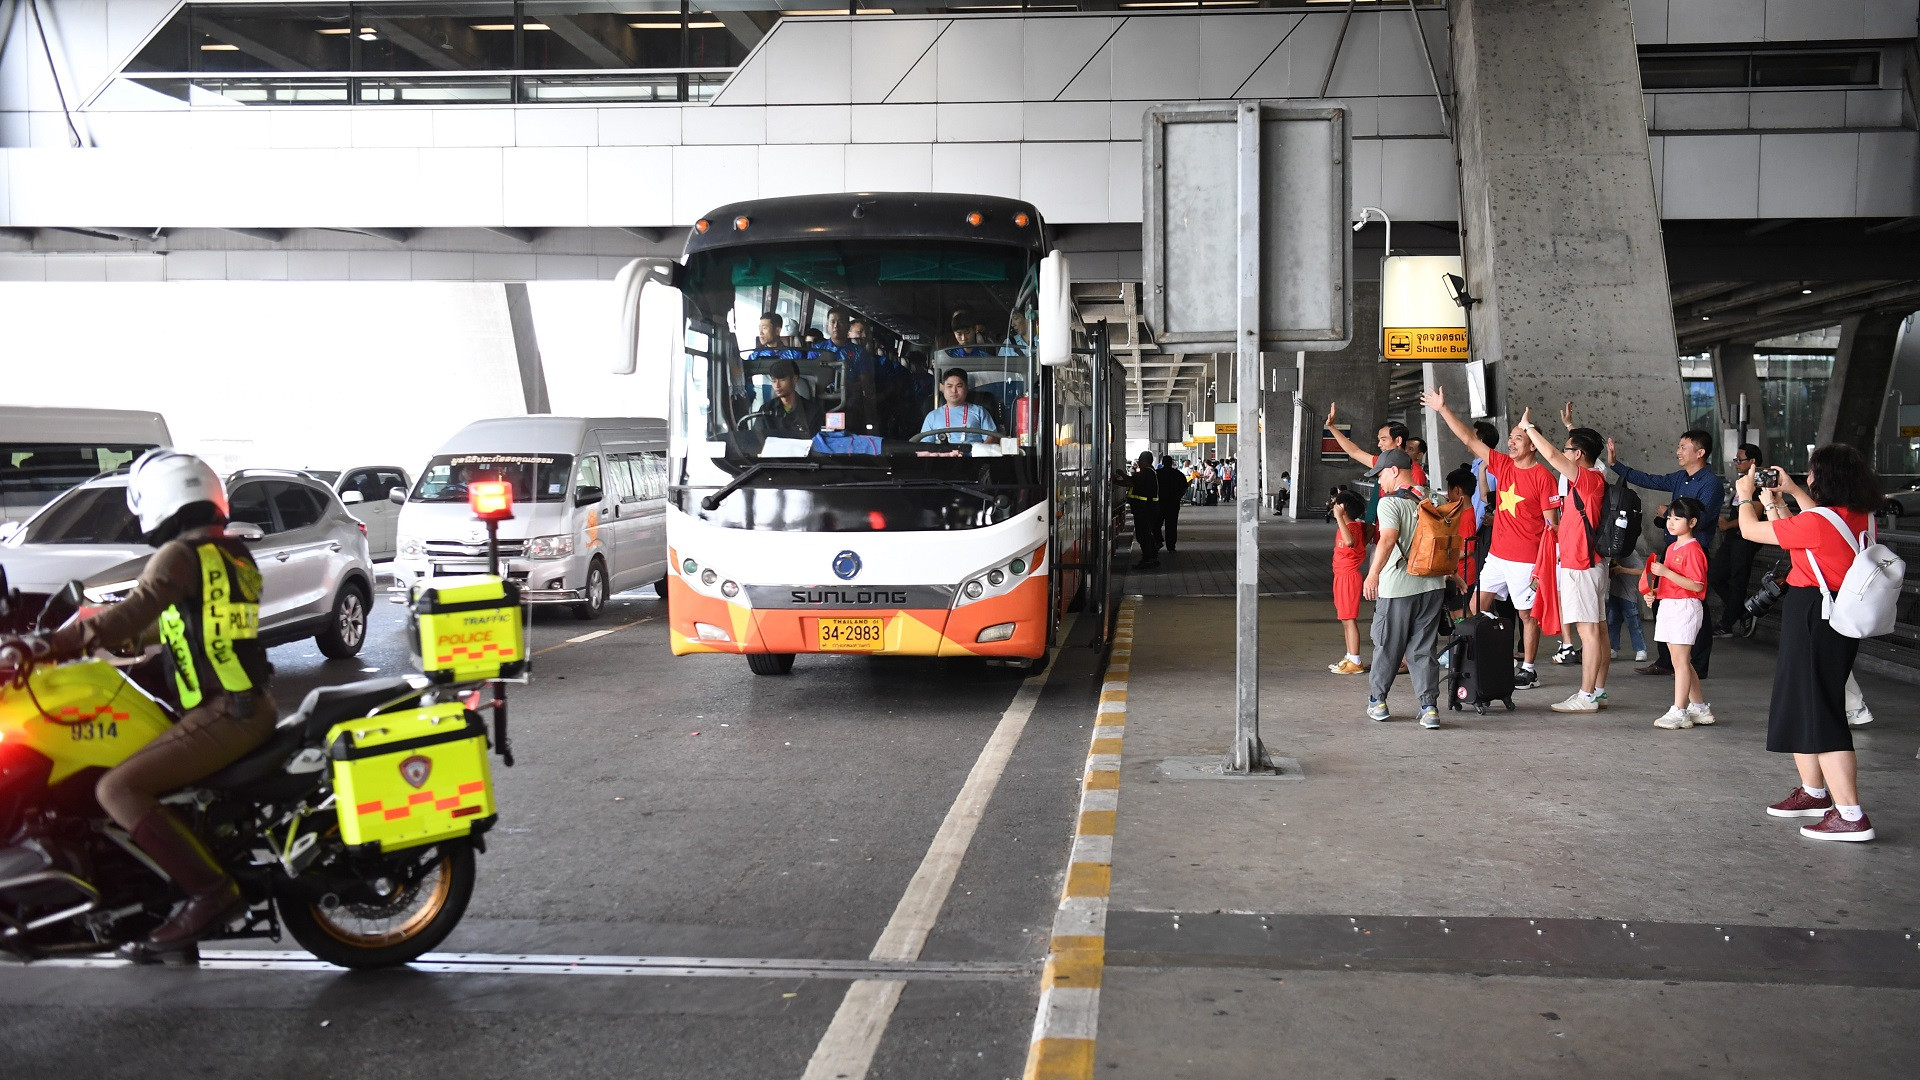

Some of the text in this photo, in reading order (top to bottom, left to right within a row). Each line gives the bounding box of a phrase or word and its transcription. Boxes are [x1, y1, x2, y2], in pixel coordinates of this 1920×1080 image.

[1416, 345, 1467, 353] Shuttle Bus
[791, 591, 907, 603] SUNLONG
[209, 570, 231, 665] POLICE
[463, 614, 511, 626] TRAFFIC
[438, 630, 494, 647] POLICE
[822, 625, 880, 641] 34-2983
[71, 722, 118, 741] 9314
